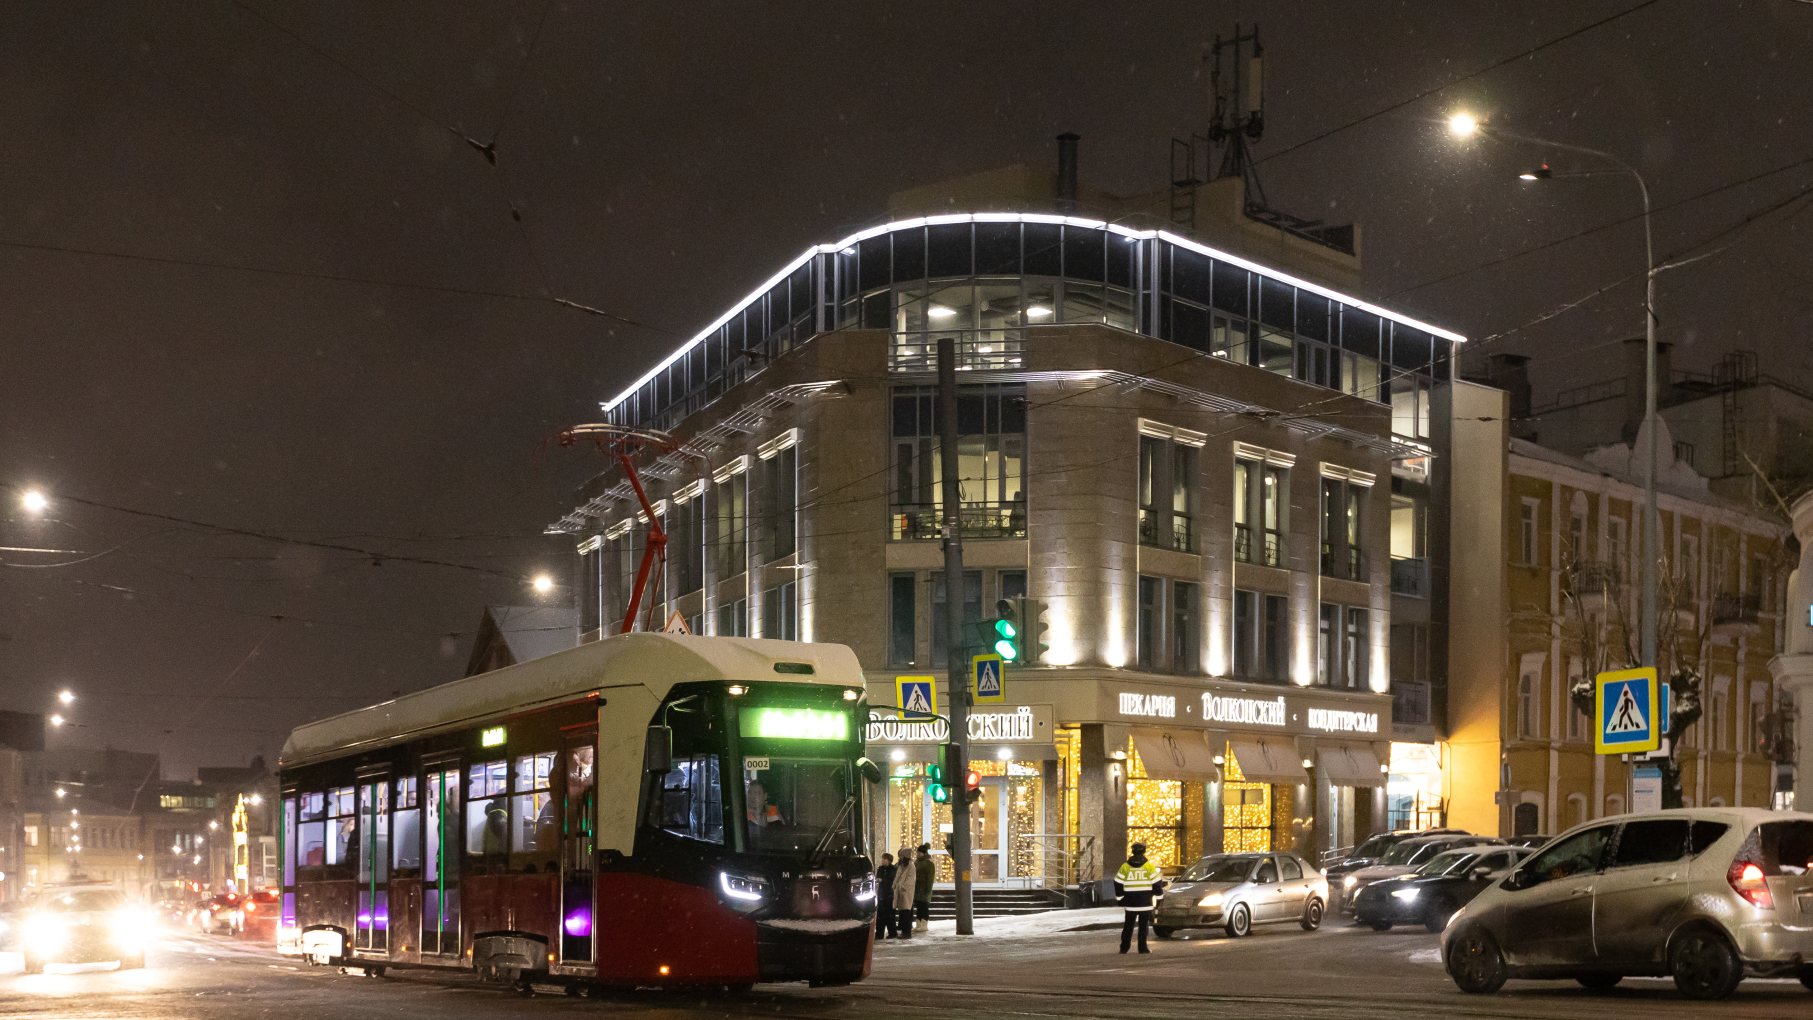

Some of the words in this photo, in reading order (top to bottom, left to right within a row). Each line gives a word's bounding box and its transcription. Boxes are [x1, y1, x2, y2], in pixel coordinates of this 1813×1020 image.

[1119, 693, 1176, 717] ПЕКАРНЯ
[1308, 708, 1378, 733] КОНДИТЕРСКАЯ
[746, 760, 769, 769] 0002
[1126, 870, 1148, 881] ДПС
